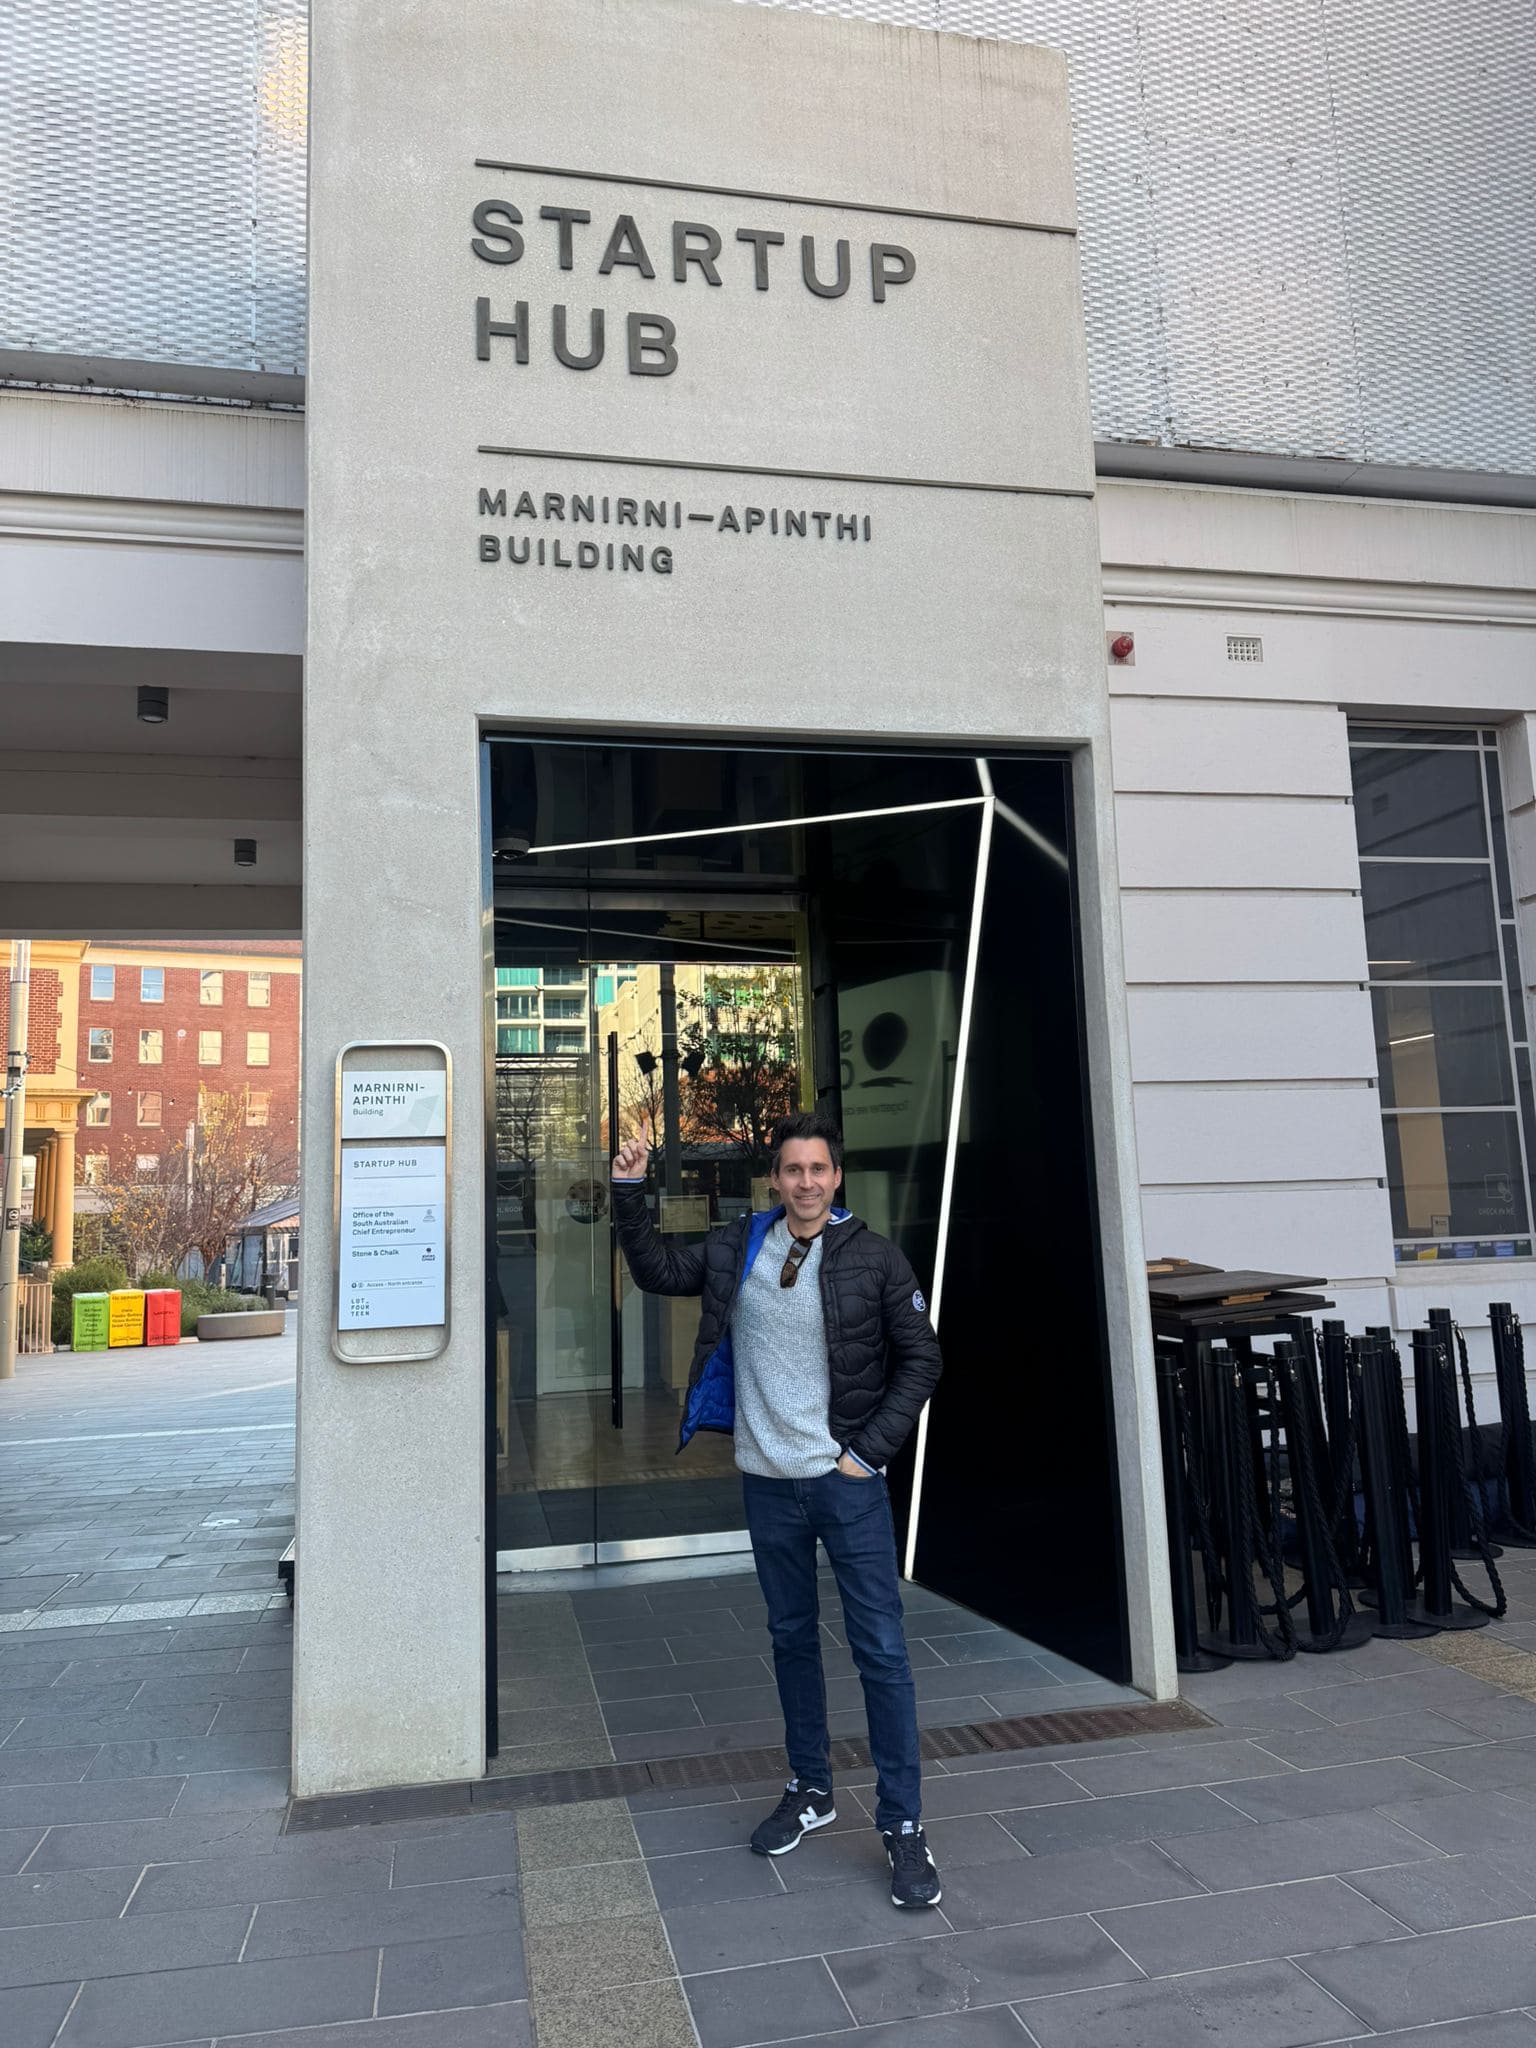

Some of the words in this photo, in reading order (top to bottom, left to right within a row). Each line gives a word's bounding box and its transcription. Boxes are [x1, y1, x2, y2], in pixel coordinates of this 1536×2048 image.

[471, 199, 916, 303] STARTUP
[476, 296, 679, 377] HUB
[480, 534, 673, 574] BUILDING
[353, 1083, 425, 1092] MARNIRNI-
[352, 1095, 406, 1105] APINTHI
[352, 1108, 384, 1116] Building
[353, 1160, 395, 1168] STARTUP
[398, 1159, 418, 1167] HUB
[374, 1219, 409, 1227] Australian
[371, 1227, 416, 1236] Entrepreneur
[352, 1250, 372, 1258] Stone
